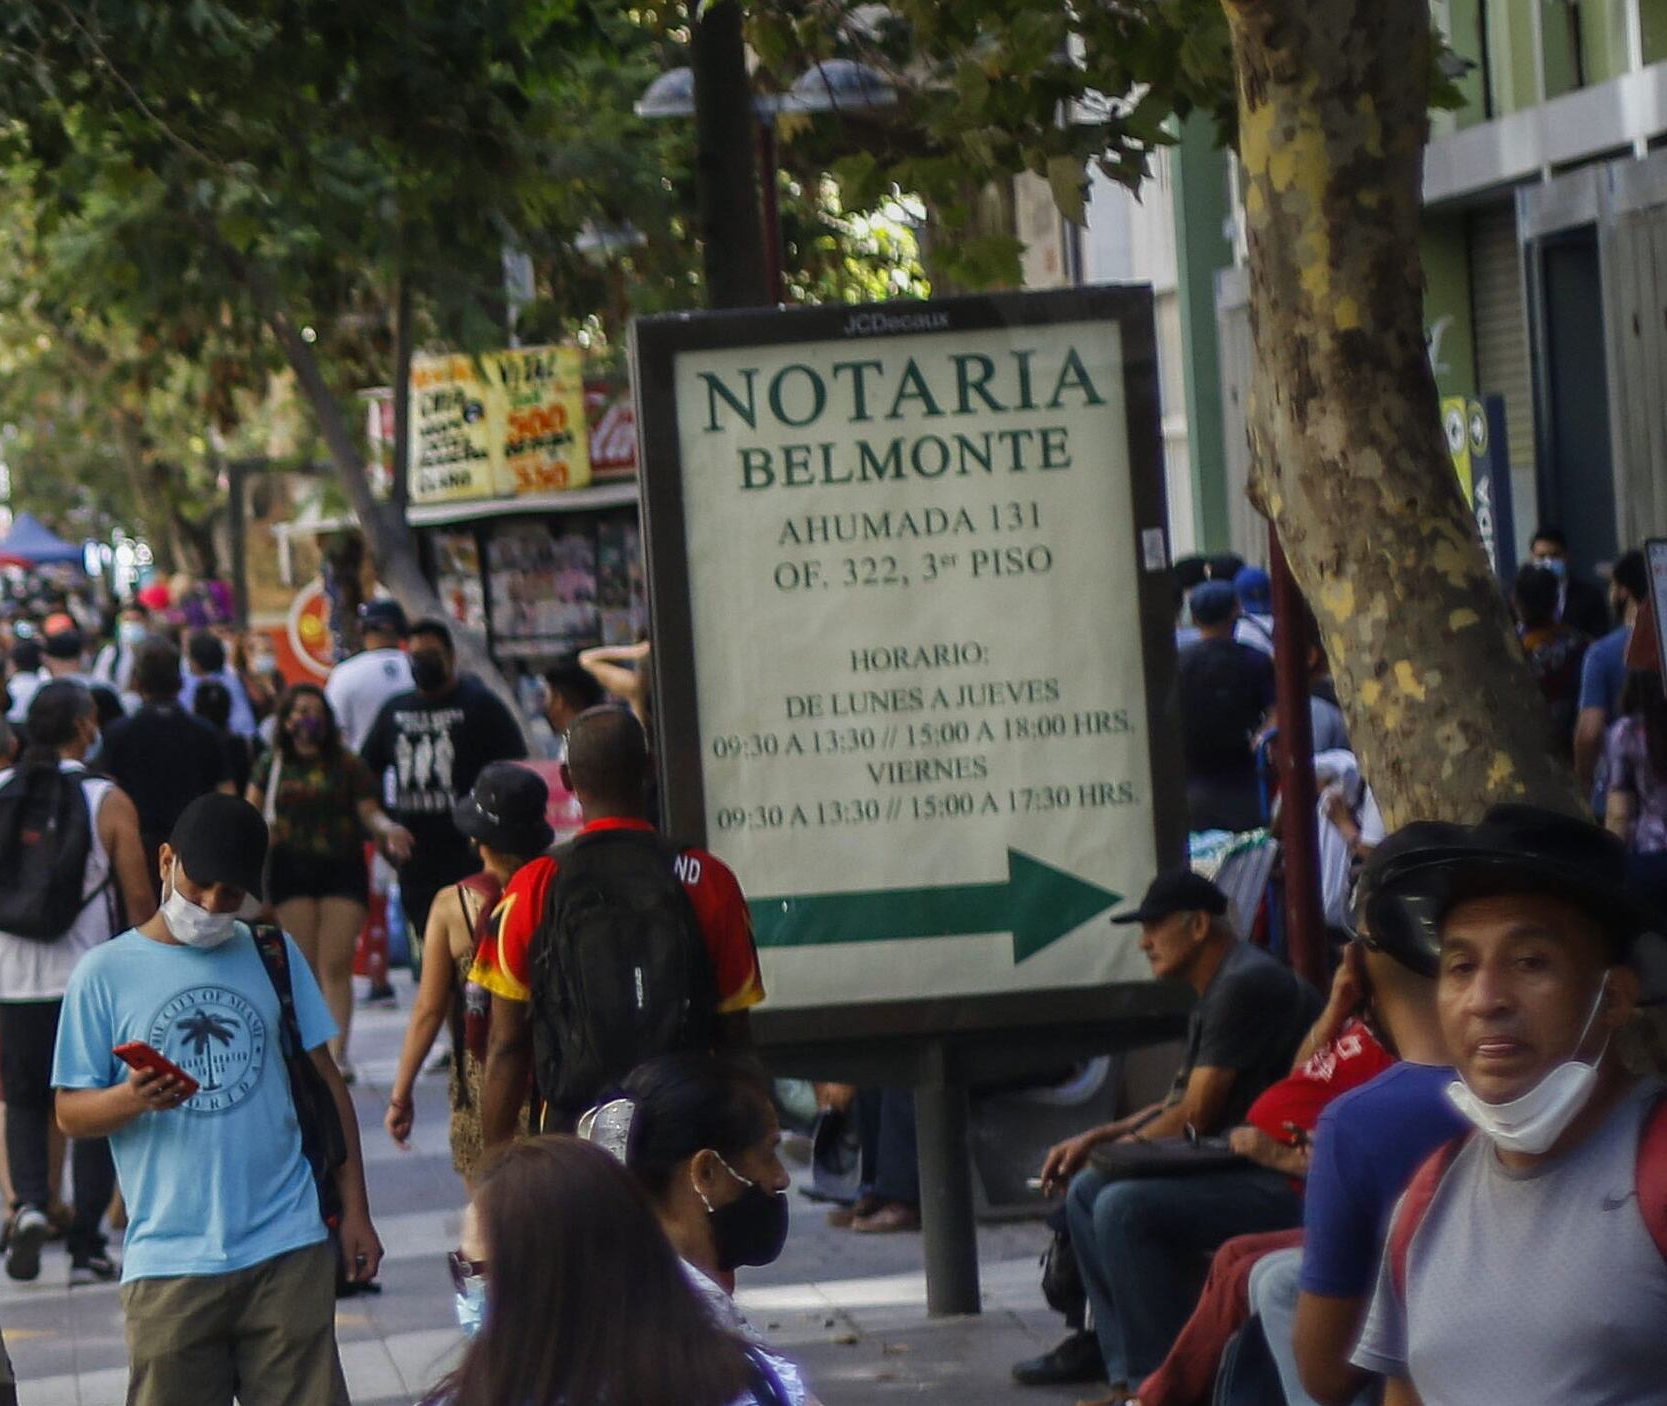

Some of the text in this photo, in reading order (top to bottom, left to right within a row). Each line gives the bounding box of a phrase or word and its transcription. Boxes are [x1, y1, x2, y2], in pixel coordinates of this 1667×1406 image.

[844, 311, 949, 335] JCDecaux
[697, 345, 1107, 432] NOTARIA
[737, 426, 1072, 491] BELMONTE
[779, 501, 1041, 545] AHUMADA 131
[774, 560, 828, 591] OF.
[843, 556, 909, 587] 322,
[971, 544, 1054, 578] PISO
[851, 641, 989, 673] HORARIO:
[786, 678, 1060, 718] DE LUNES A JUEVES
[713, 732, 779, 758] 09:30
[786, 733, 804, 755] A
[814, 727, 875, 753] 13:30
[908, 720, 969, 747] 15:00
[978, 719, 995, 742] A
[1004, 714, 1066, 741] 18:00
[1073, 709, 1134, 735] HRS.
[868, 755, 988, 785] VIERNES
[717, 805, 783, 830] 09:30
[790, 803, 807, 827] A
[818, 798, 880, 825] 13:30
[913, 792, 974, 819] 15:00
[981, 791, 999, 815] A
[1009, 785, 1071, 813] 17:30
[1078, 781, 1140, 807] HRS.
